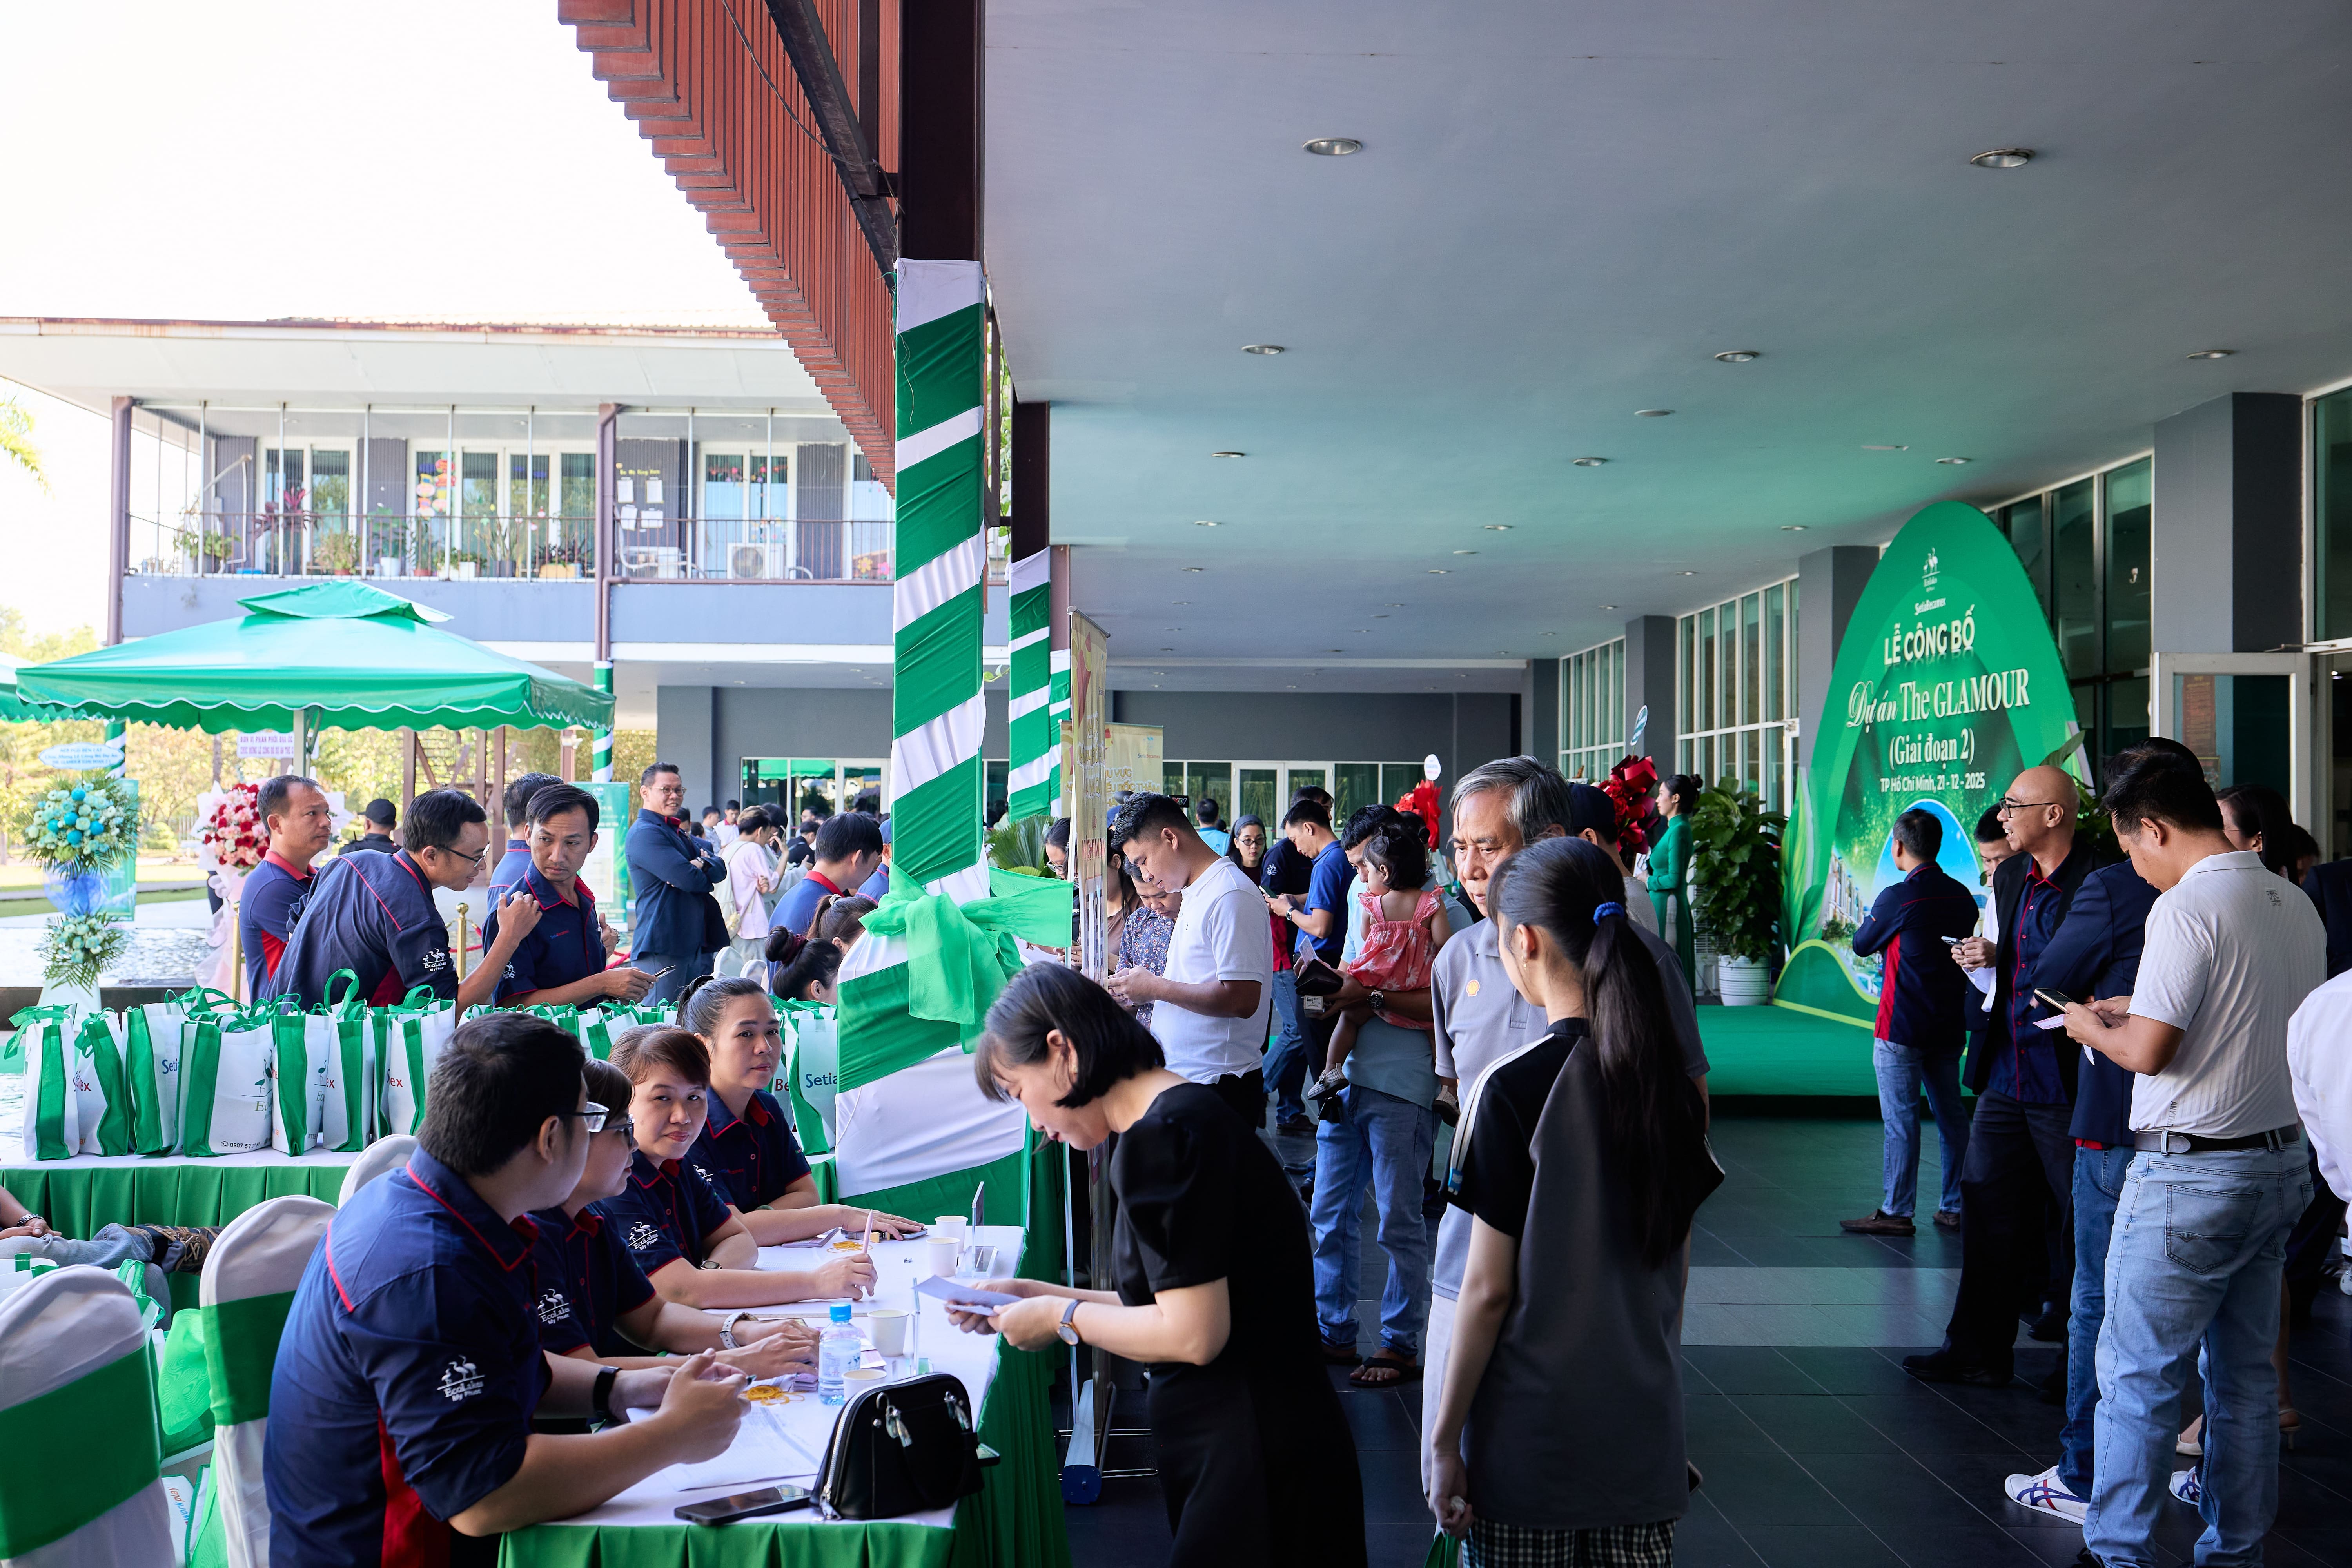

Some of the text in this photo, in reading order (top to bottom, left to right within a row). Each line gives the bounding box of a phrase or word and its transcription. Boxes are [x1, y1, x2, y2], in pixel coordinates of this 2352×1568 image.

[1914, 597, 1946, 615] SetiaBecamex
[1884, 604, 1975, 666] LỄ CÔNG BỐ
[1877, 690, 1897, 722] án
[1899, 681, 1930, 722] The
[1934, 668, 2030, 718] GLAMOUR
[1889, 728, 1975, 770] (Giai đoạn 2)
[1114, 767, 1132, 779] VỰC
[1117, 780, 1136, 791] BỐC
[1137, 781, 1160, 792] THĂM
[1880, 778, 1890, 792] TP
[1902, 775, 1915, 792] Chí
[1916, 774, 1936, 793] Minh,
[1937, 775, 1945, 791] 21
[1951, 773, 1959, 790] 12
[1965, 772, 1985, 789] 2025
[1172, 797, 1188, 805] VTV
[633, 1233, 659, 1249] EcoLakes
